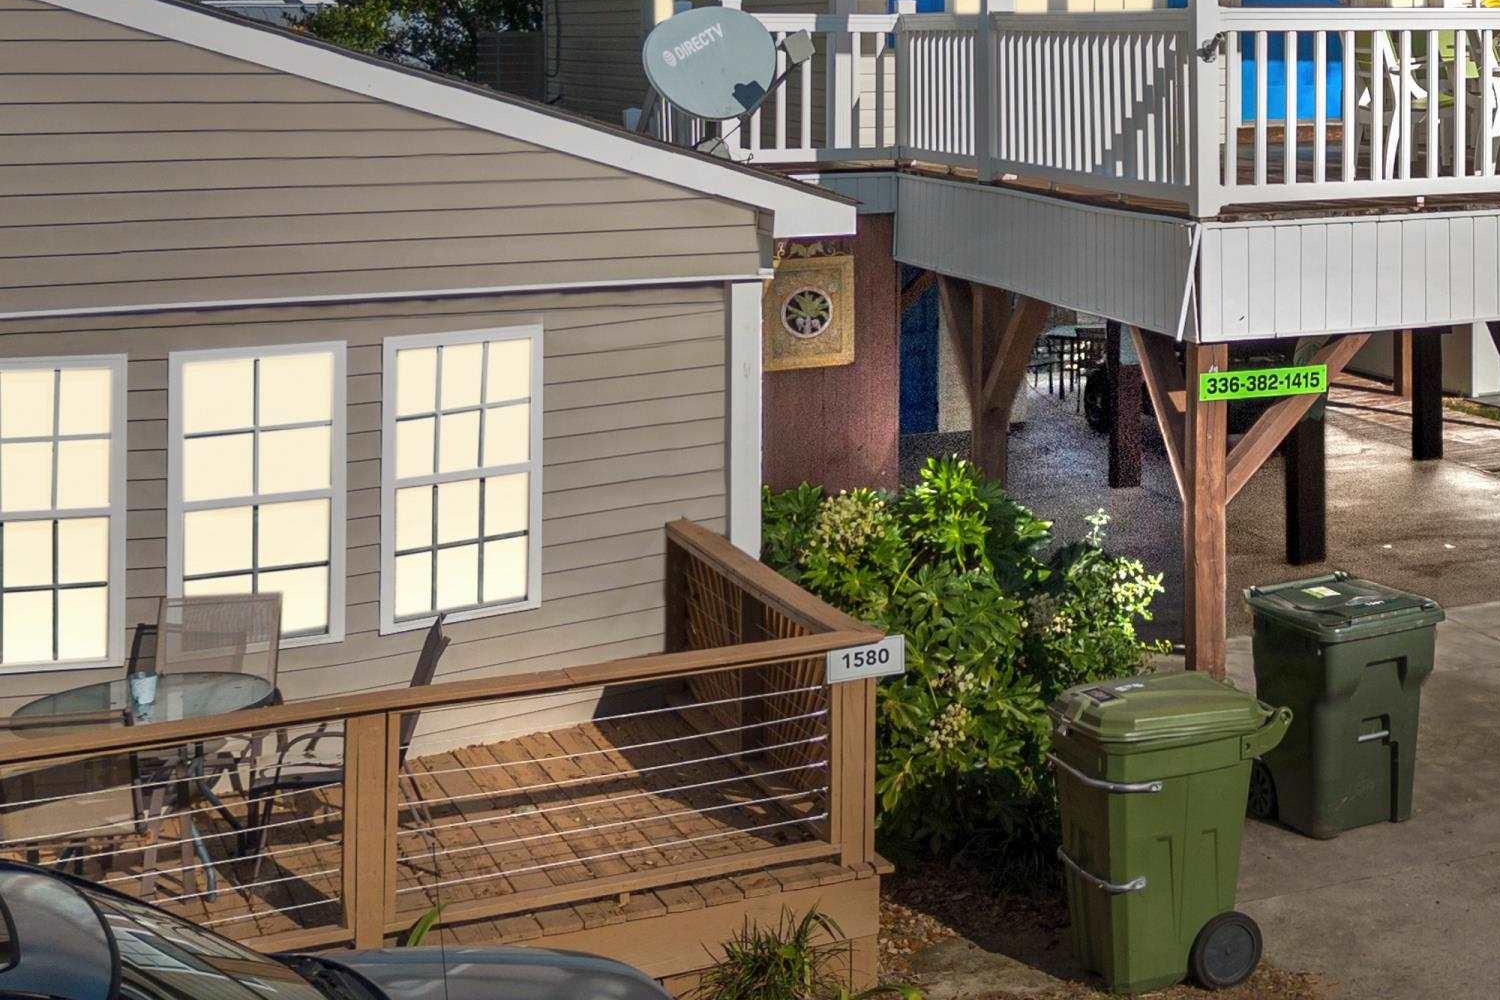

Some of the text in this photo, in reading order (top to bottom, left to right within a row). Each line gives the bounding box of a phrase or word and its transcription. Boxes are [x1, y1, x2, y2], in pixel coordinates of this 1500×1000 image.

[674, 23, 724, 60] DIRECTV
[1206, 372, 1320, 395] 336-382-1415
[842, 648, 890, 669] 1580
